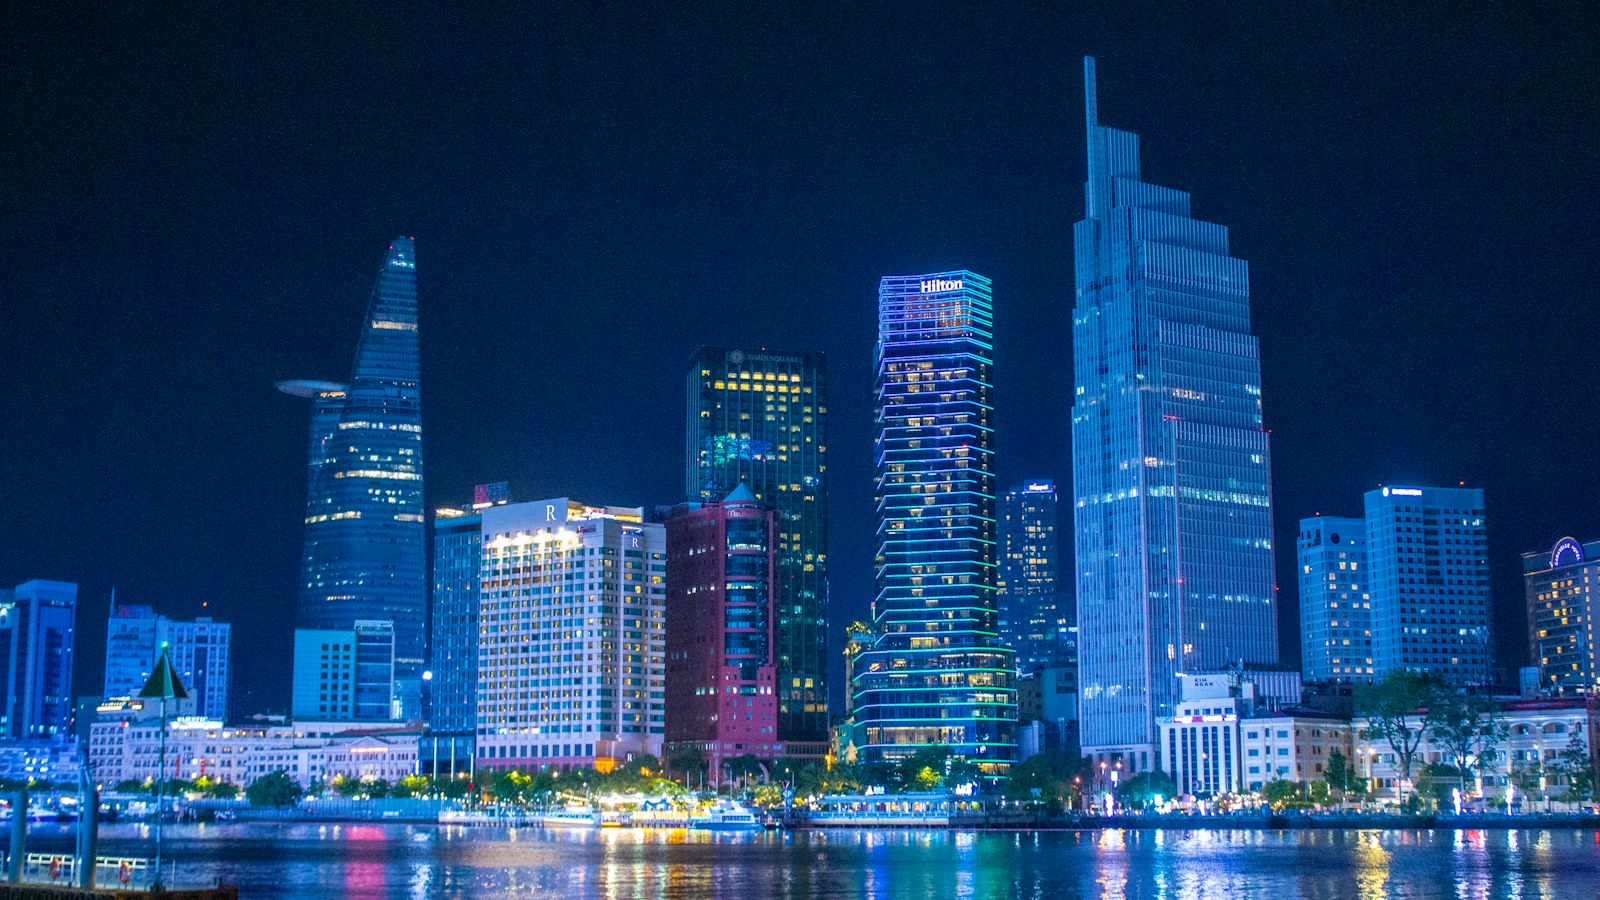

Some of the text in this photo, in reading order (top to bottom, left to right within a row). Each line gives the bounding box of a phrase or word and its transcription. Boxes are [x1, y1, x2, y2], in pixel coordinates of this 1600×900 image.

[921, 279, 963, 293] Hilton
[770, 355, 799, 363] SQUARE
[546, 504, 557, 521] R
[632, 537, 639, 547] R
[1554, 543, 1581, 567] CARAVELLE HOTEL
[627, 753, 633, 762] R
